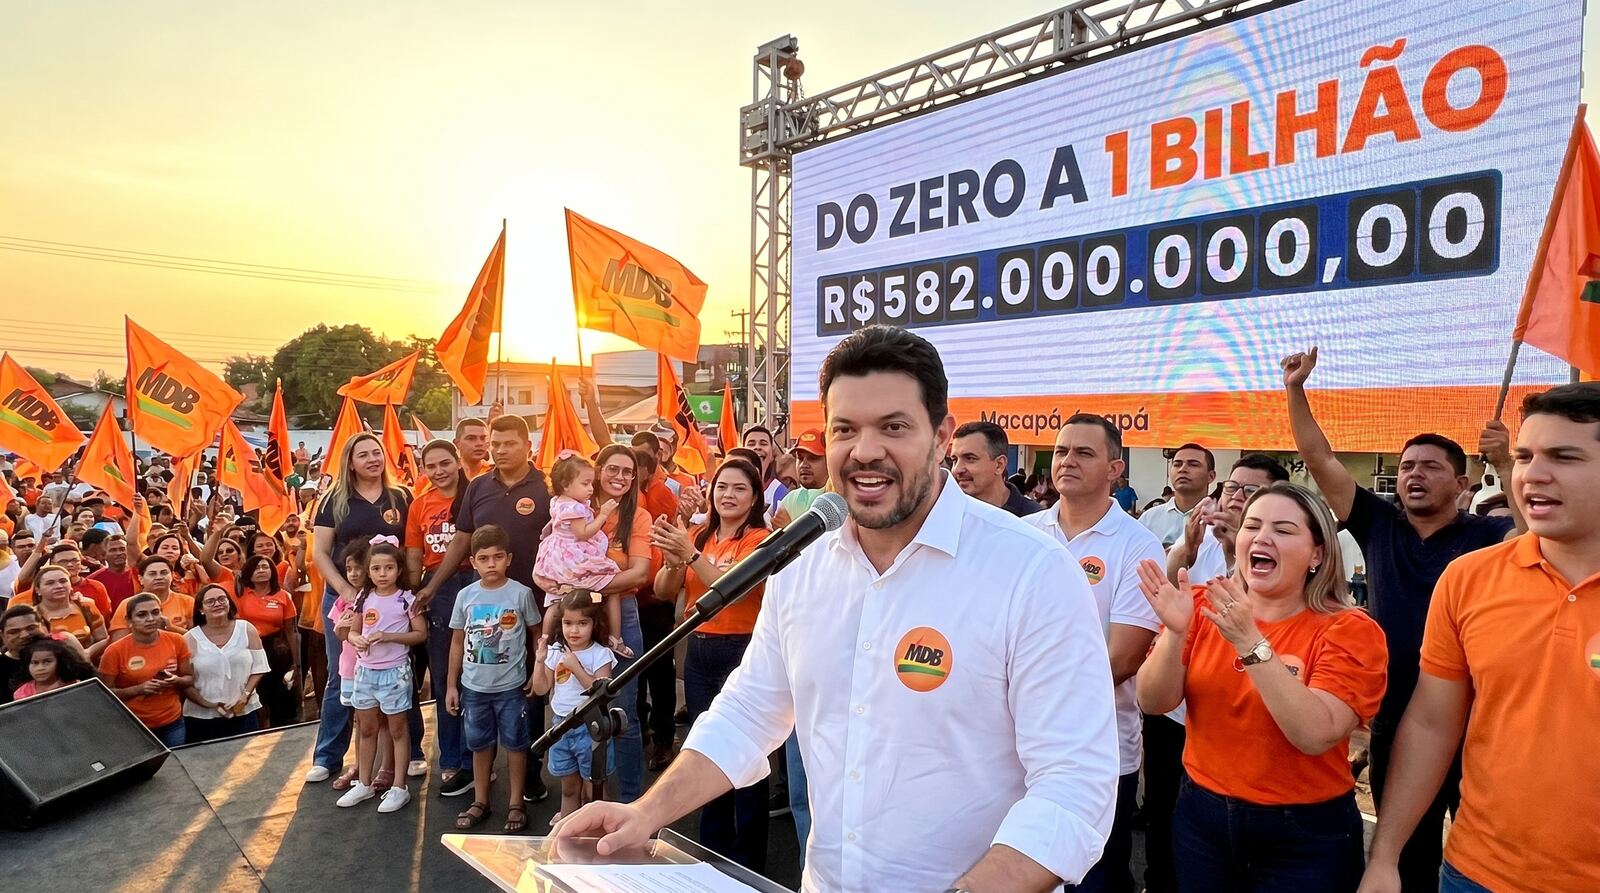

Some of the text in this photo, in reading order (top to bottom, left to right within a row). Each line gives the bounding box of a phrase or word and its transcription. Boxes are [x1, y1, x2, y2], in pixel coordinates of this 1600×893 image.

[816, 38, 1509, 251] DO ZERO A 1 BILHÃO
[824, 191, 1485, 325] R$582.000.000,00
[601, 258, 672, 309] MDB
[1, 388, 60, 431] MDB
[136, 366, 200, 414] MDB
[904, 643, 943, 666] MDB
